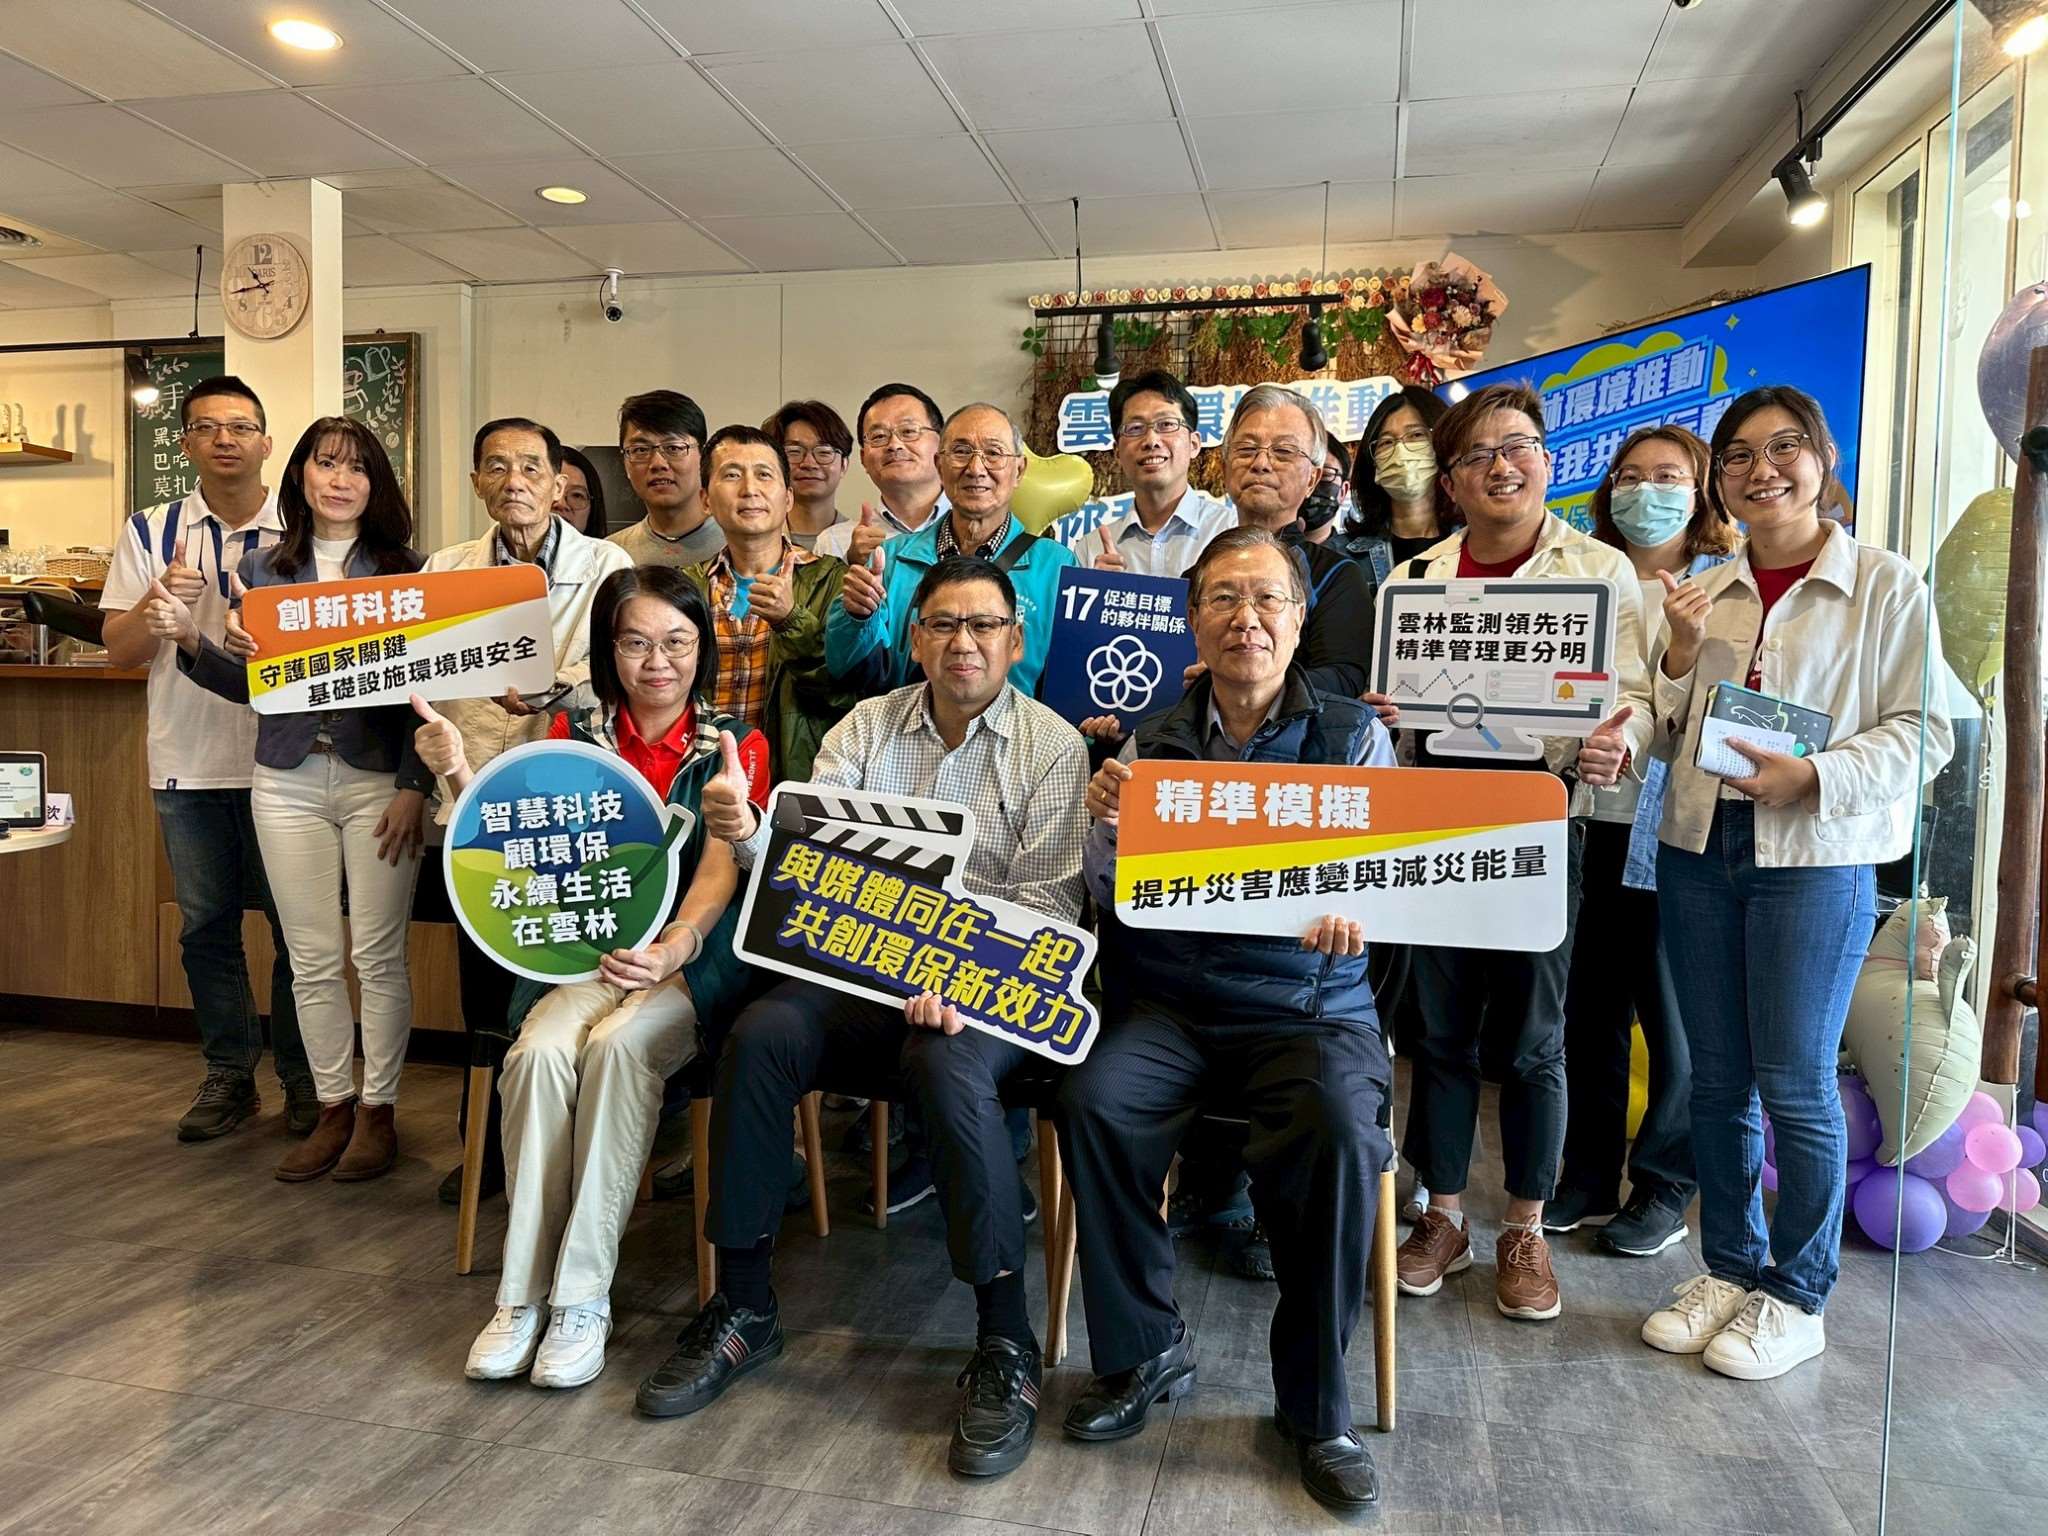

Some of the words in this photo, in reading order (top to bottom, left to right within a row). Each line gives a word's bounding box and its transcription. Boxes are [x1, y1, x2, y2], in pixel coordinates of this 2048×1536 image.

[253, 243, 272, 265] 12
[276, 588, 427, 632] 創新科技
[1061, 585, 1099, 621] 17
[1100, 608, 1187, 635] 的夥伴關係
[1103, 588, 1173, 613] 促進目標
[1397, 611, 1589, 636] 雲林監測領先行
[260, 633, 407, 687] 守護國家關鍵
[308, 635, 537, 707] 基礎設施環境與安全
[1395, 638, 1587, 664] 精準管理更分明
[480, 789, 625, 834] 智慧科技
[1154, 779, 1371, 831] 精準模擬
[503, 830, 610, 870] 顧環保
[490, 866, 632, 910] 永續生活
[1131, 844, 1548, 911] 提升災害應變與減災能量
[511, 906, 619, 947] 在雲林
[773, 842, 1077, 984] 與媒體同在一起
[780, 900, 1085, 1045] 共創環保新效力
